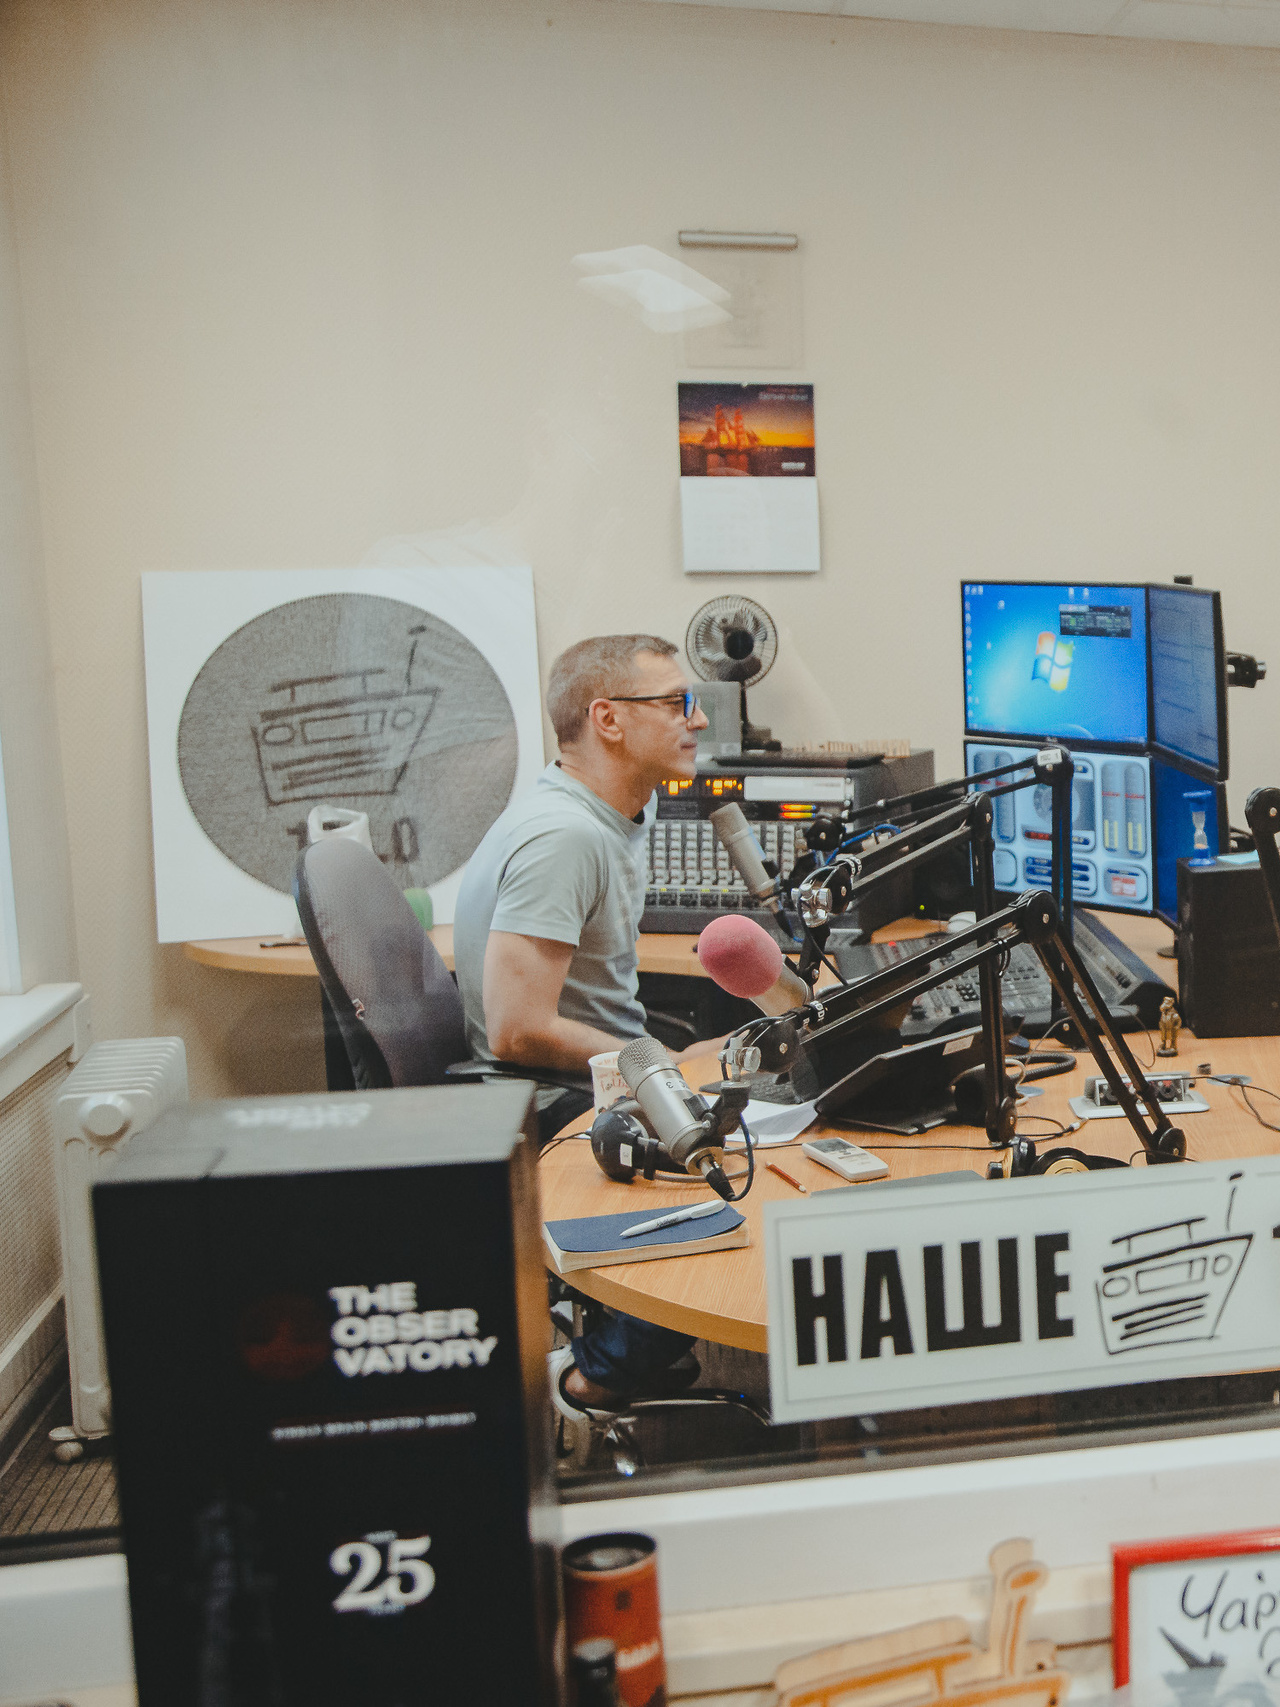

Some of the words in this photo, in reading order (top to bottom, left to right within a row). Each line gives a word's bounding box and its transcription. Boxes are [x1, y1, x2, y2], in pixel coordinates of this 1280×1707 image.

[328, 1280, 418, 1315] THE
[792, 1232, 1075, 1366] НАШЕ
[330, 1307, 480, 1348] OBSER
[332, 1334, 499, 1378] VATORY
[328, 1534, 437, 1613] 25
